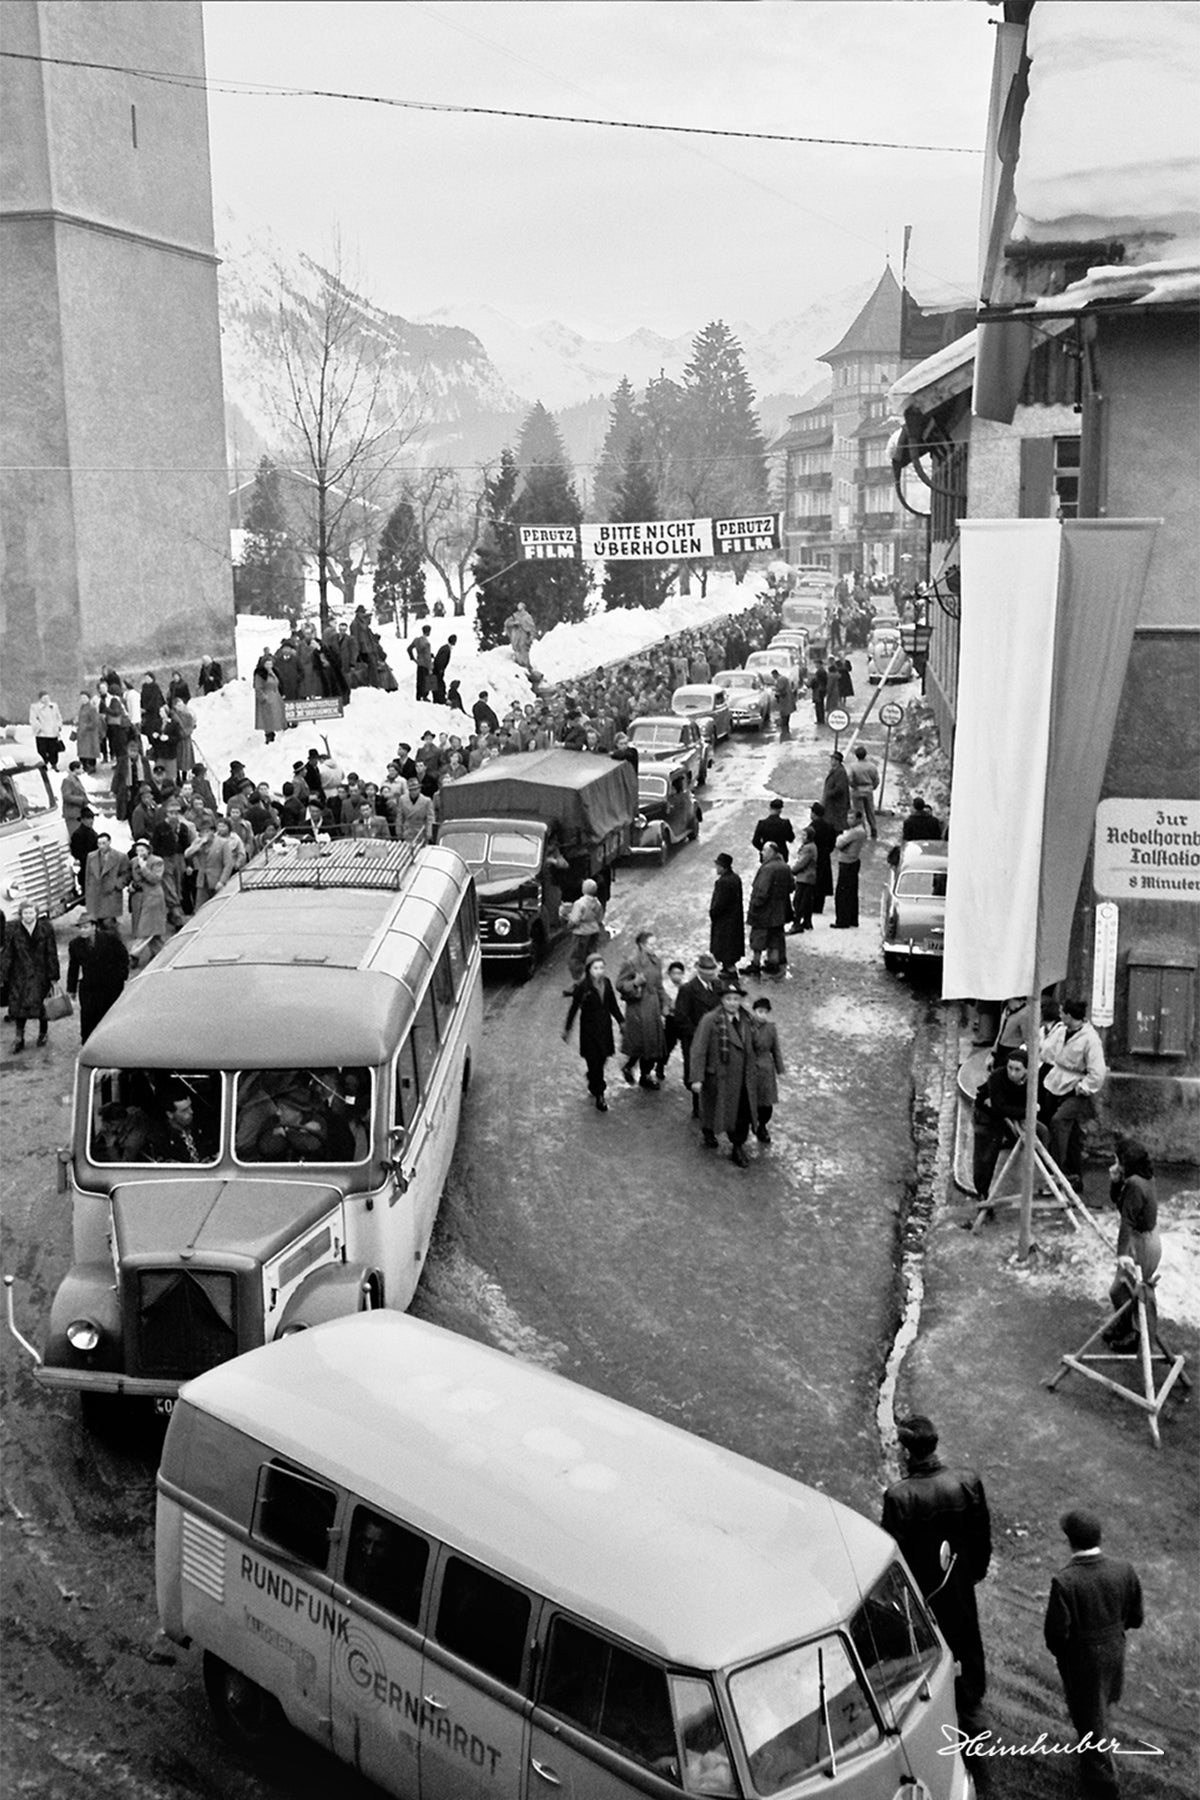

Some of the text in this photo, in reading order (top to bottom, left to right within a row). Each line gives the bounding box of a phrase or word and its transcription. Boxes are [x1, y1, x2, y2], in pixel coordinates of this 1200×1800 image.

[522, 529, 574, 542] PERUTZ
[600, 522, 695, 541] BITTE NICHT
[719, 519, 771, 536] PERUTZ
[524, 544, 575, 559] FILM
[593, 538, 702, 556] ÜBERHOLEN
[721, 536, 773, 554] FILM
[1156, 810, 1189, 826] Zur
[1128, 875, 1138, 889] 8
[241, 1553, 351, 1645] RUNDFUNK
[348, 1649, 502, 1776] GERNHARDT
